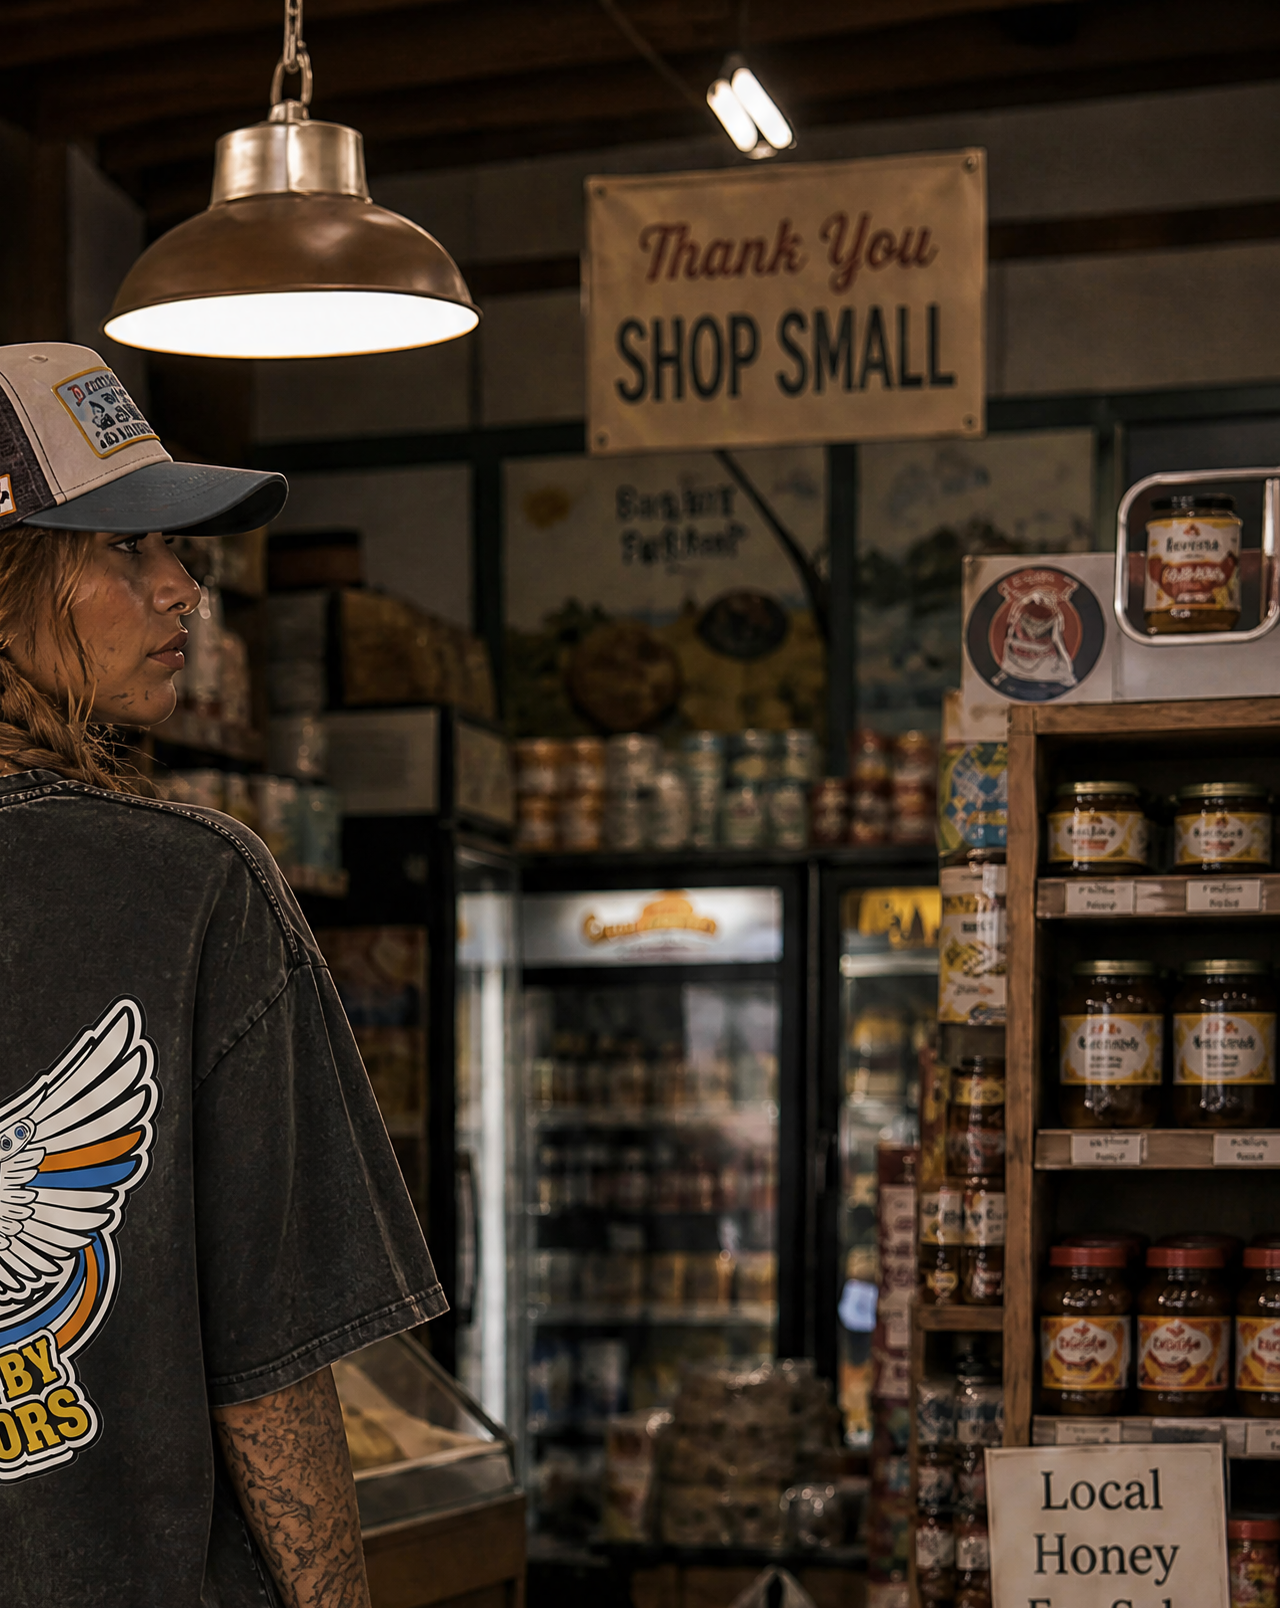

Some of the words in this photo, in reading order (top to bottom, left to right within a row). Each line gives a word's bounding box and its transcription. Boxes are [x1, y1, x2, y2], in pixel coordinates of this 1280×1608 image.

[640, 219, 809, 284] Thank
[820, 212, 938, 294] You
[615, 312, 761, 405] SHOP
[776, 303, 956, 398] SMALL
[1041, 1468, 1163, 1512] Local
[1035, 1531, 1180, 1585] Honey
